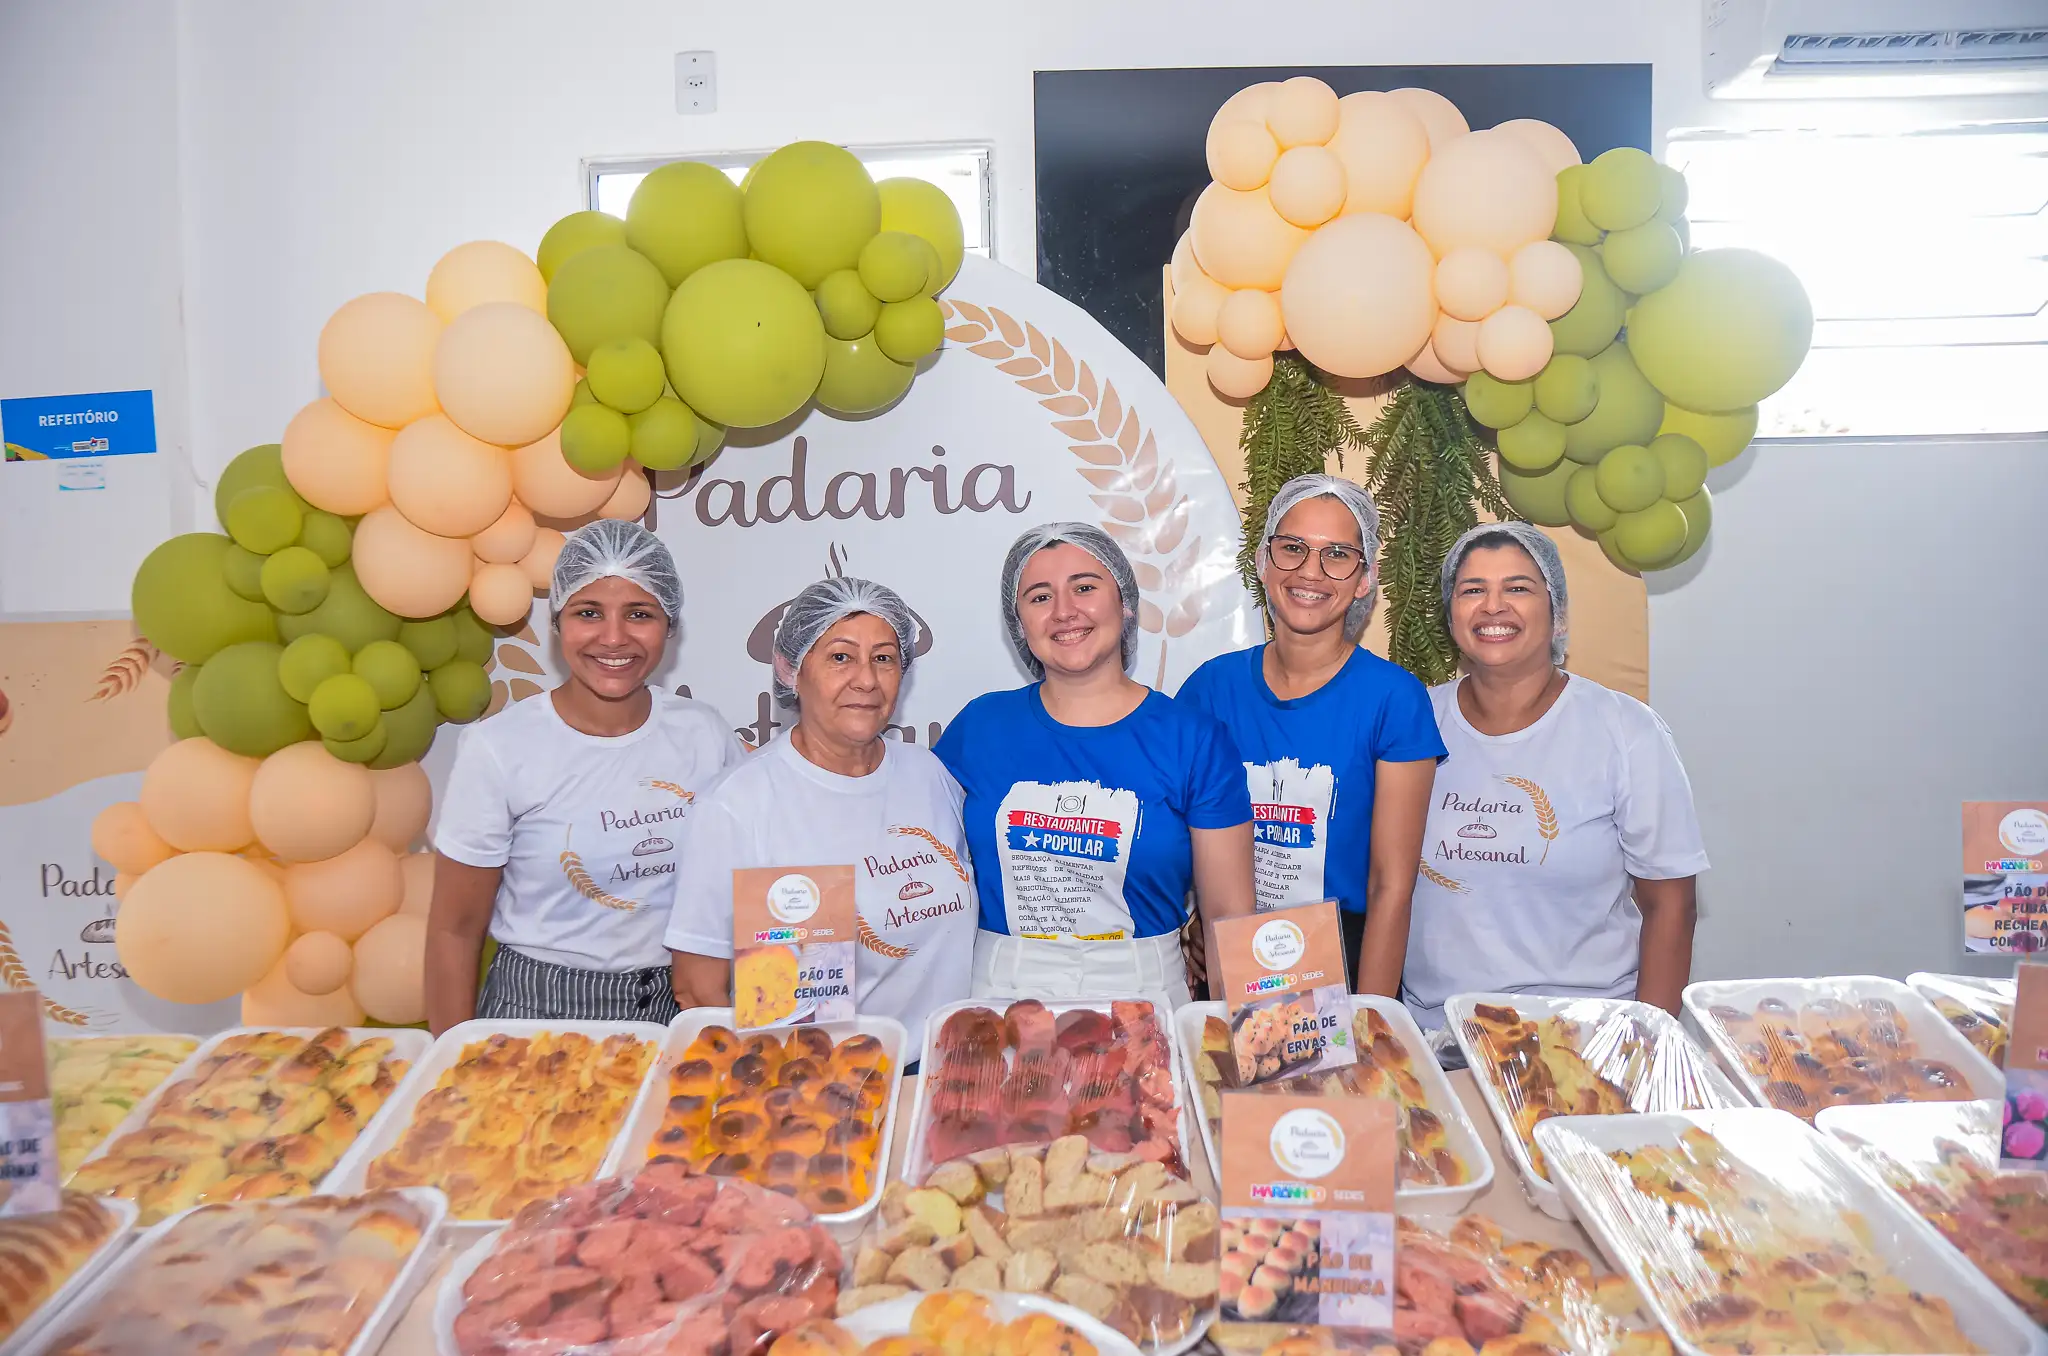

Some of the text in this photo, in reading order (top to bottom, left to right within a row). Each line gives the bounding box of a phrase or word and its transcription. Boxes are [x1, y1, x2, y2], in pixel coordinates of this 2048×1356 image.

[39, 410, 119, 427] REFEITÓRIO
[1441, 792, 1524, 814] Padaria
[600, 807, 686, 832] Padaria
[1023, 812, 1105, 835] RESTAURANTE
[1043, 833, 1104, 857] POPULAR
[1435, 840, 1529, 864] Artesanal
[864, 850, 937, 878] Padaria
[1011, 854, 1052, 863] SEGURANÇA
[2004, 883, 2048, 897] PÃO D
[884, 893, 965, 930] Artesanal
[1994, 920, 2048, 931] RECHEA
[800, 967, 844, 981] PÃO DE
[794, 984, 849, 999] CENOURA
[1293, 1015, 1337, 1035] PÃO DE
[1287, 1035, 1327, 1054] ERVAS
